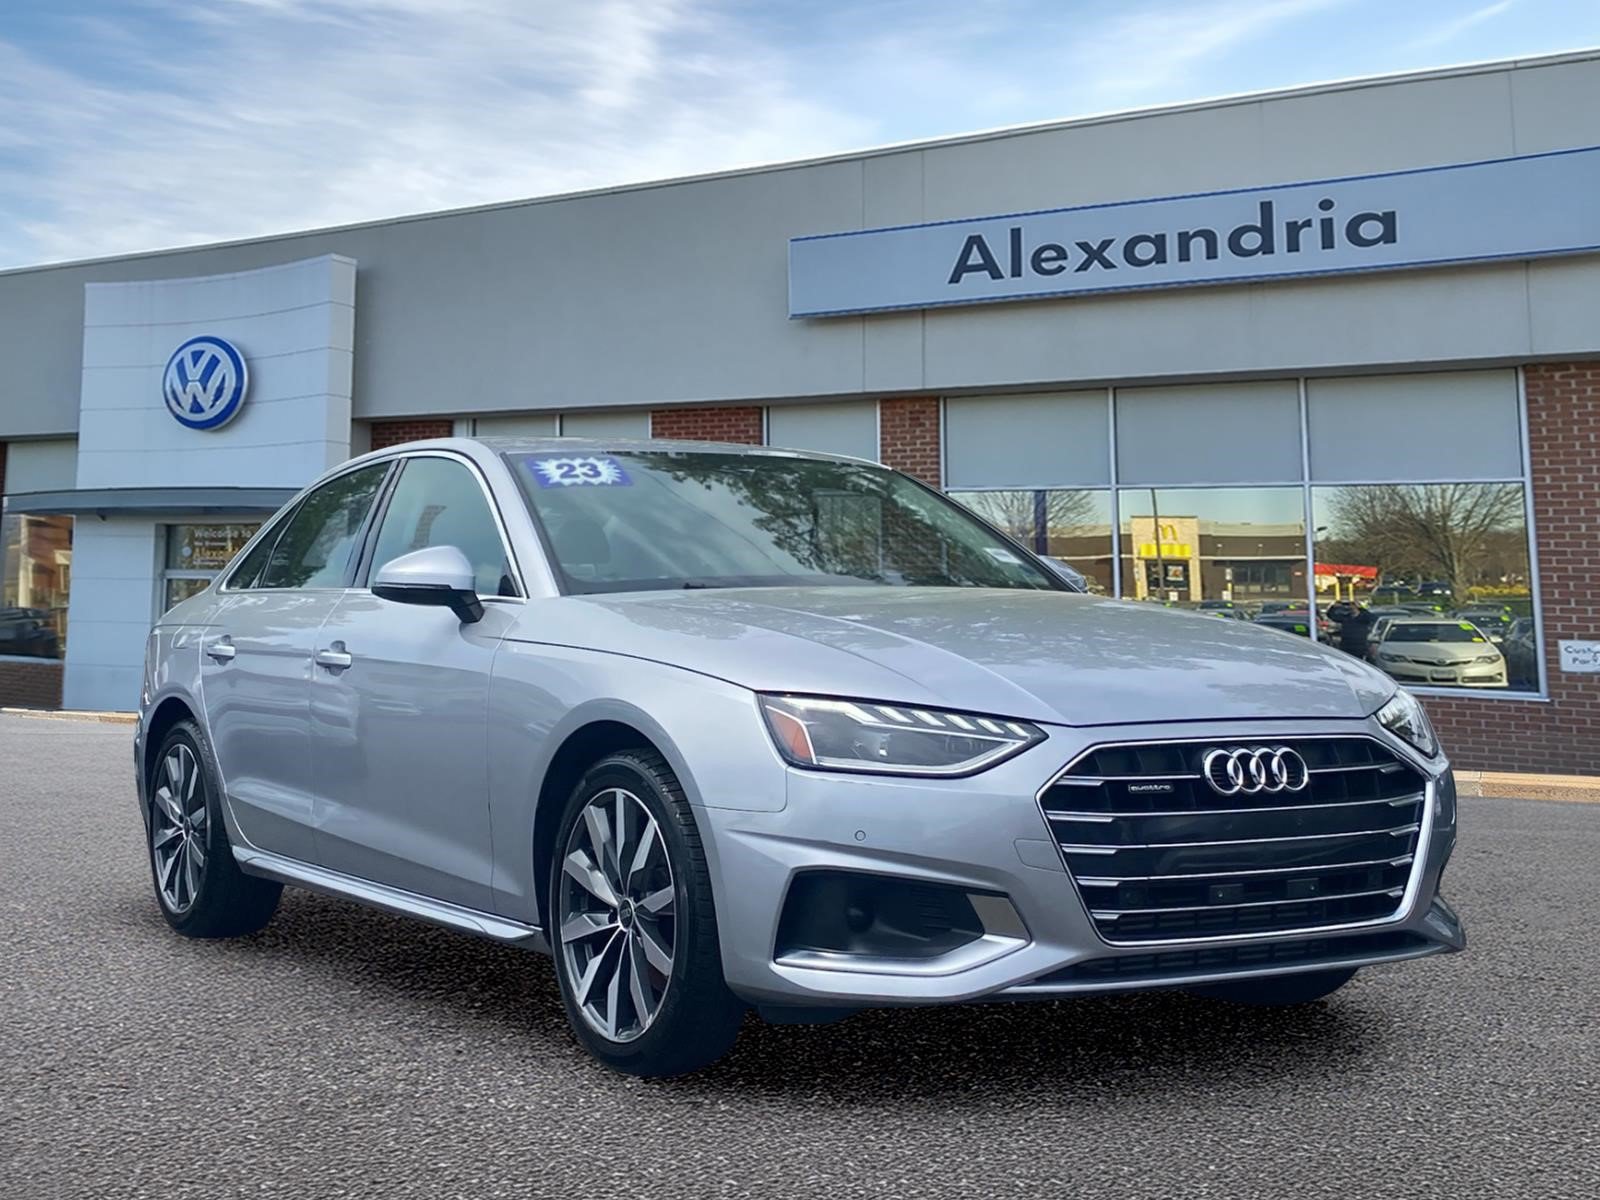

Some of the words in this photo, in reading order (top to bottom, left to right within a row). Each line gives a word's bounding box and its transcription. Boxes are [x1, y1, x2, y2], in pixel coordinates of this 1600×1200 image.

[947, 198, 1398, 285] Alexandria
[166, 341, 237, 422] VW
[556, 462, 602, 479] 23
